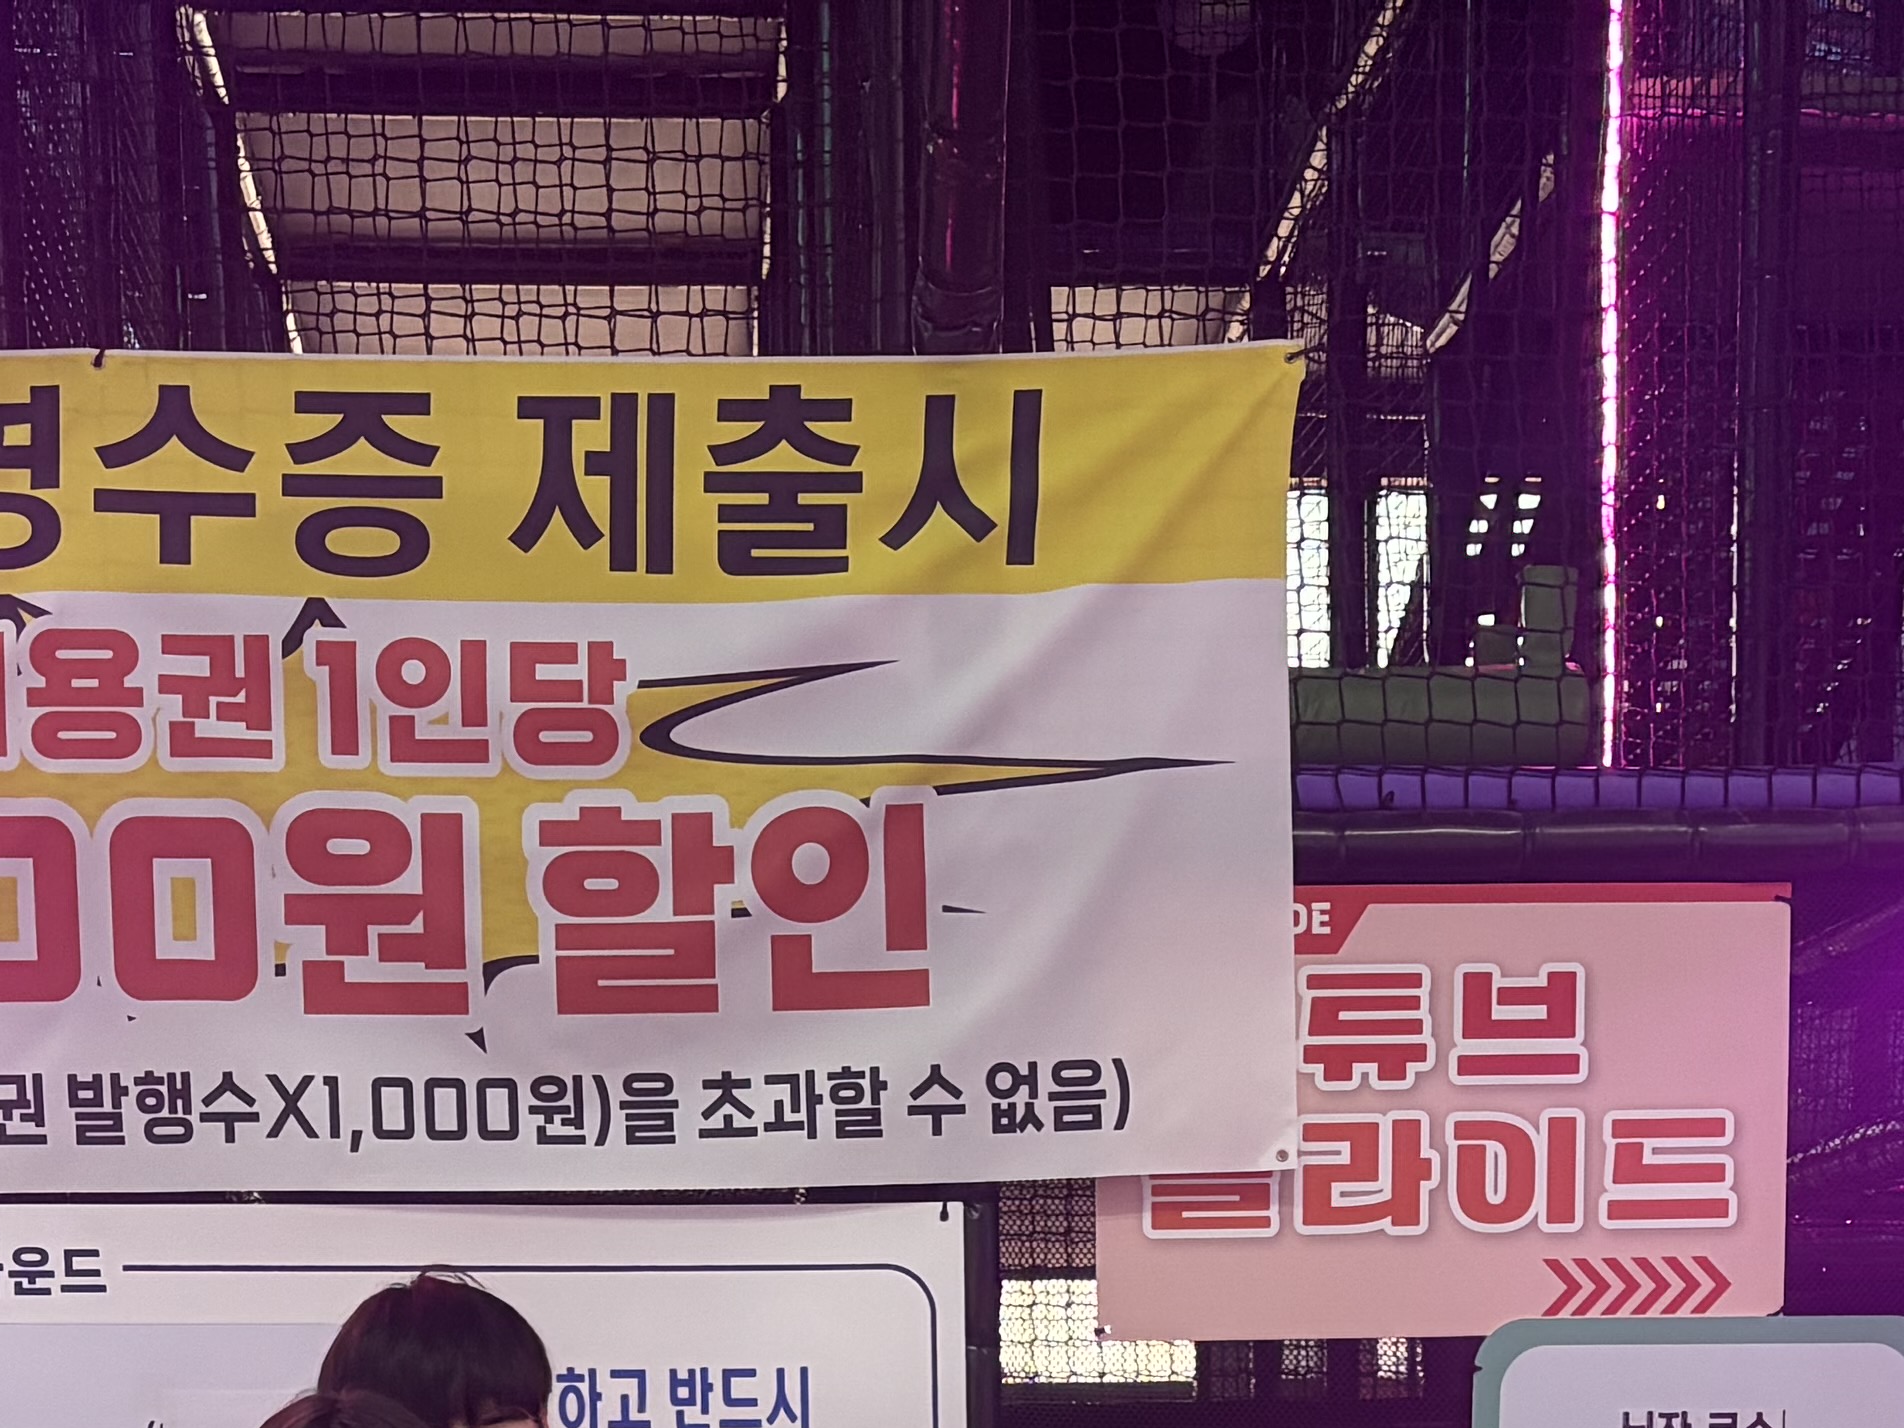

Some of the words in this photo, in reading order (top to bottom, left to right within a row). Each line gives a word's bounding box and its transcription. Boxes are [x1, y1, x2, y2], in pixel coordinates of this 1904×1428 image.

[508, 384, 1042, 576] 제출시
[316, 638, 626, 766] 1인당
[540, 805, 930, 1015] 할인
[1303, 972, 1583, 1083] 튜브
[699, 1066, 888, 1139] 초과할
[908, 1064, 966, 1136] 수
[986, 1058, 1129, 1134] 없음)
